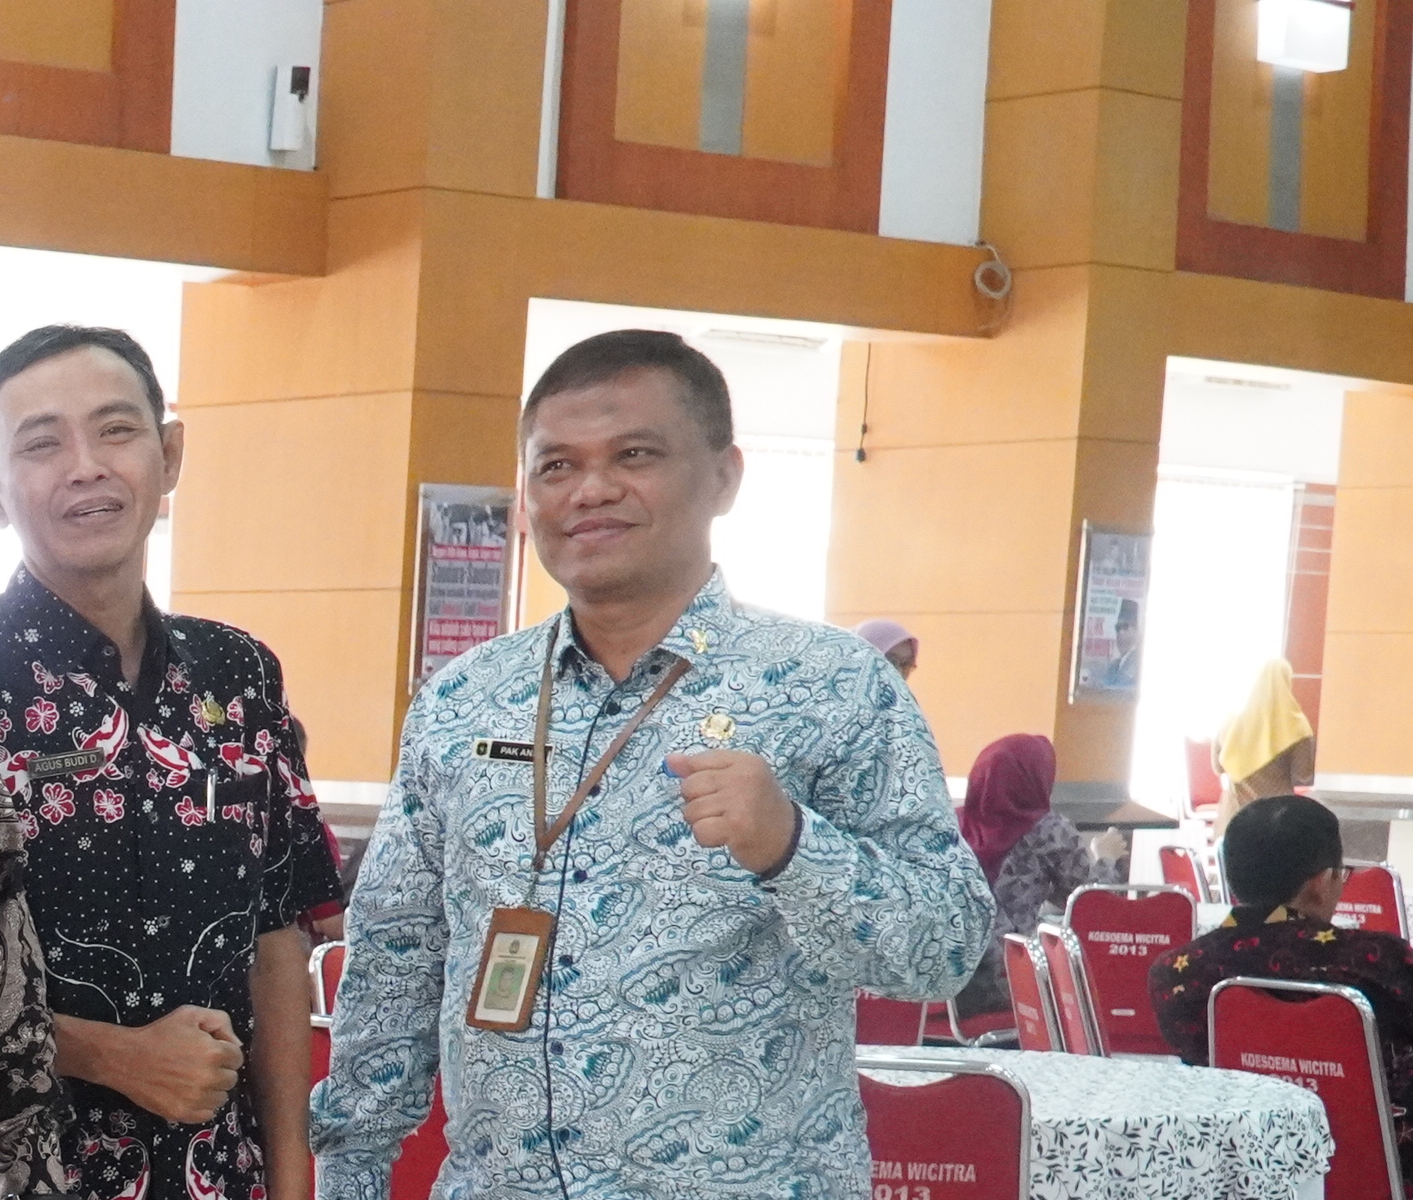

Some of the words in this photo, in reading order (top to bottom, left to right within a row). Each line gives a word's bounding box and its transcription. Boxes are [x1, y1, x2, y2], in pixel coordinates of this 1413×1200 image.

[500, 746, 518, 757] PAK
[34, 759, 63, 773] AGUS
[64, 755, 88, 767] BUDI
[89, 754, 97, 764] D
[1108, 944, 1148, 956] 2013
[1298, 1058, 1346, 1078] WICITRA
[907, 1161, 977, 1182] WICITRA
